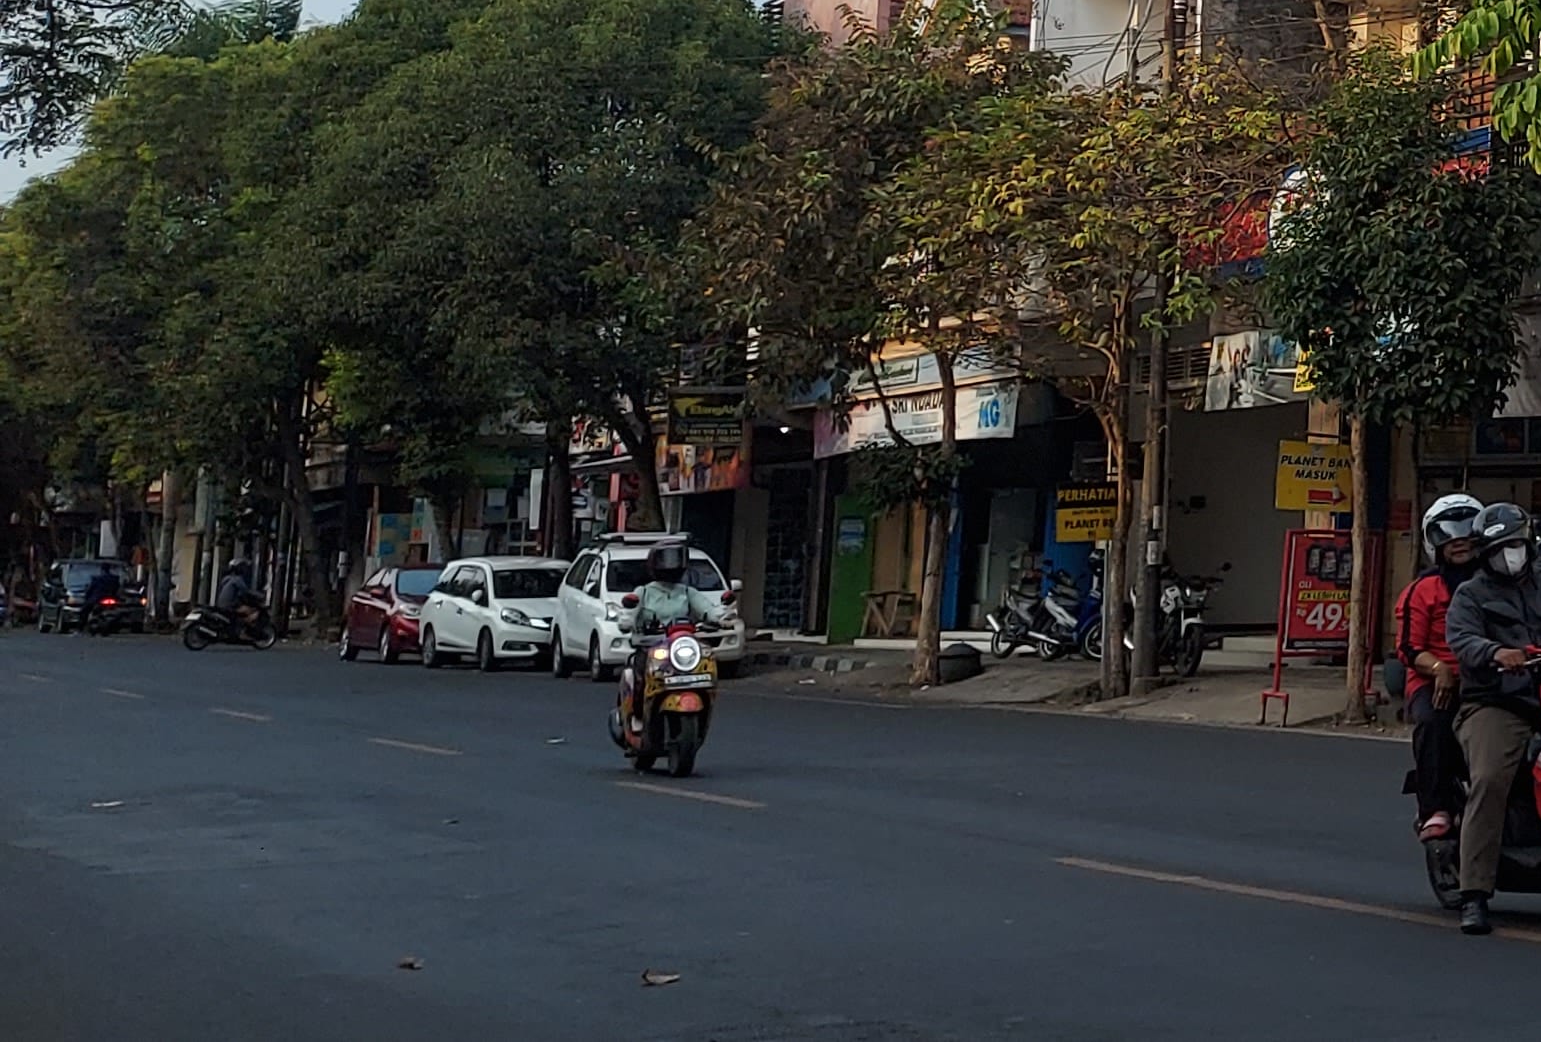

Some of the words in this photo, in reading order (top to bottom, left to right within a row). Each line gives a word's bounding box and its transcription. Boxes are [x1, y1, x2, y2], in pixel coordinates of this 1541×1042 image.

[1280, 455, 1325, 467] PLANET
[1328, 457, 1351, 469] BAN
[1294, 469, 1337, 481] MASUK
[1056, 487, 1117, 502] PERHATIA
